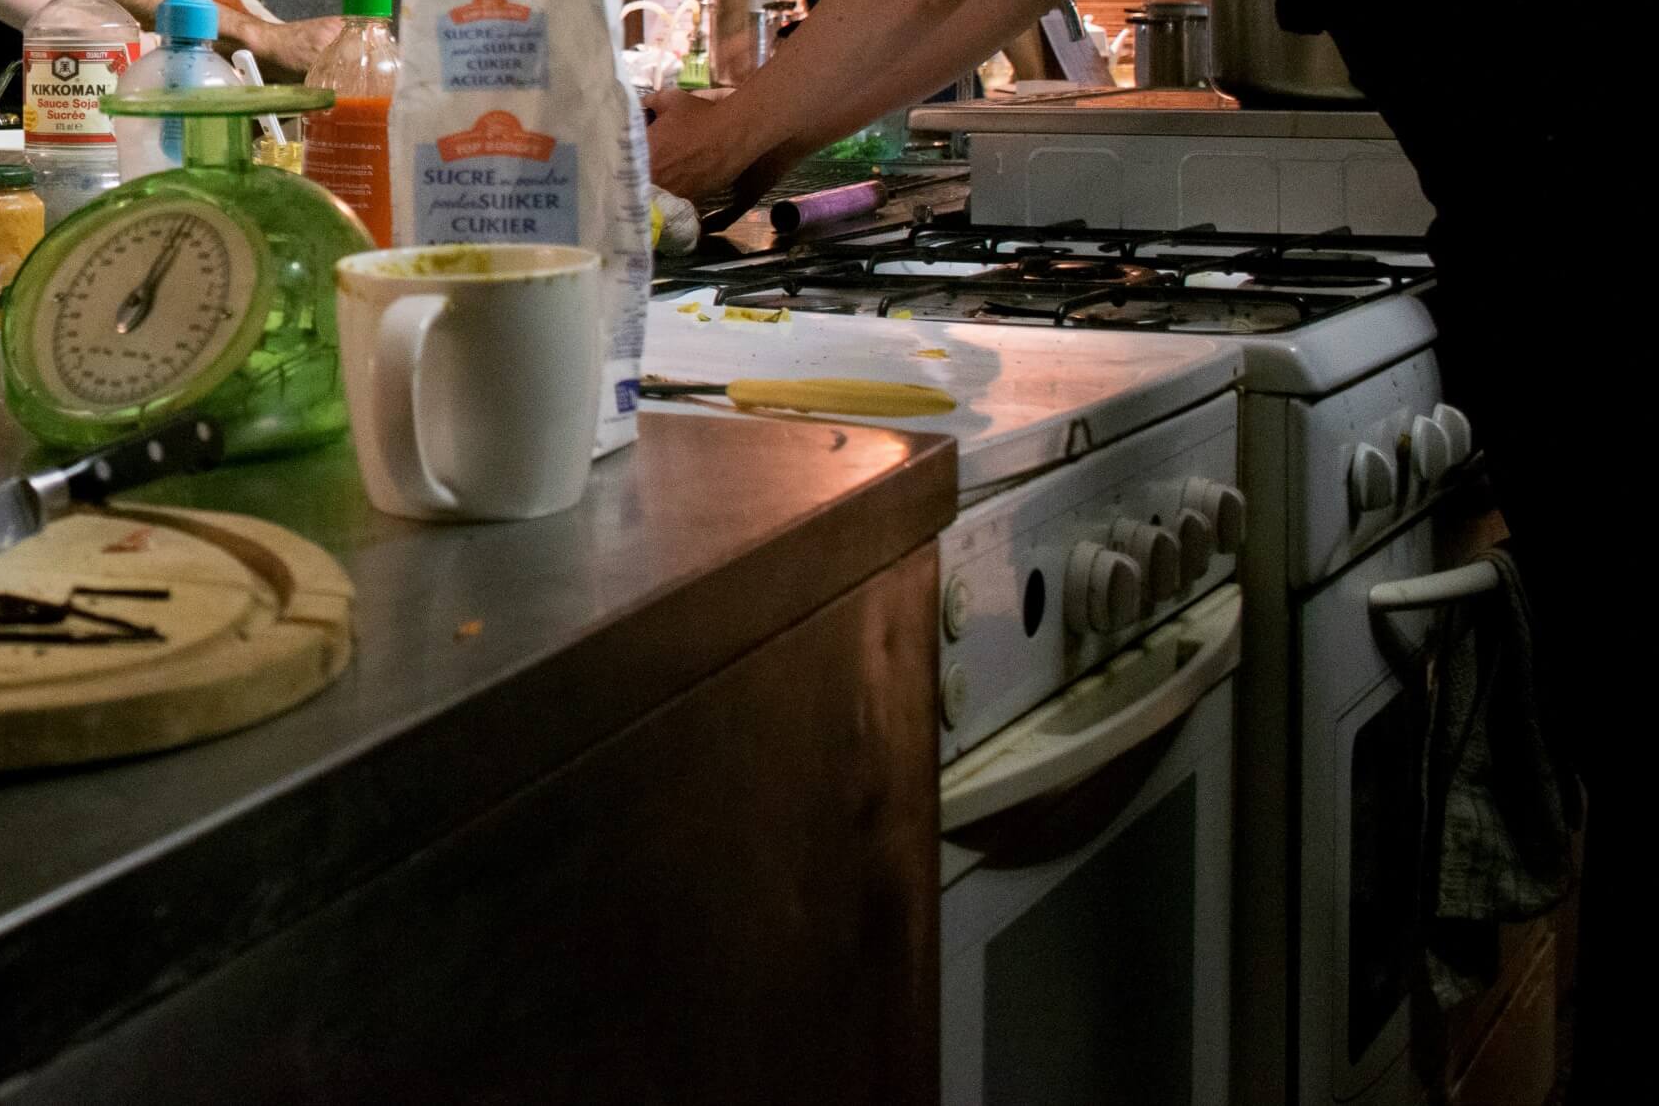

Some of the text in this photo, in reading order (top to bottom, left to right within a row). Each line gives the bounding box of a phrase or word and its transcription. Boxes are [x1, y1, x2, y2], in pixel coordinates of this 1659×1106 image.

[31, 83, 107, 97] KIKKOMAN
[37, 99, 99, 111] Sauce Soja
[47, 110, 86, 121] Sucrée
[423, 169, 496, 186] SUCRE
[451, 217, 537, 234] CUKIER
